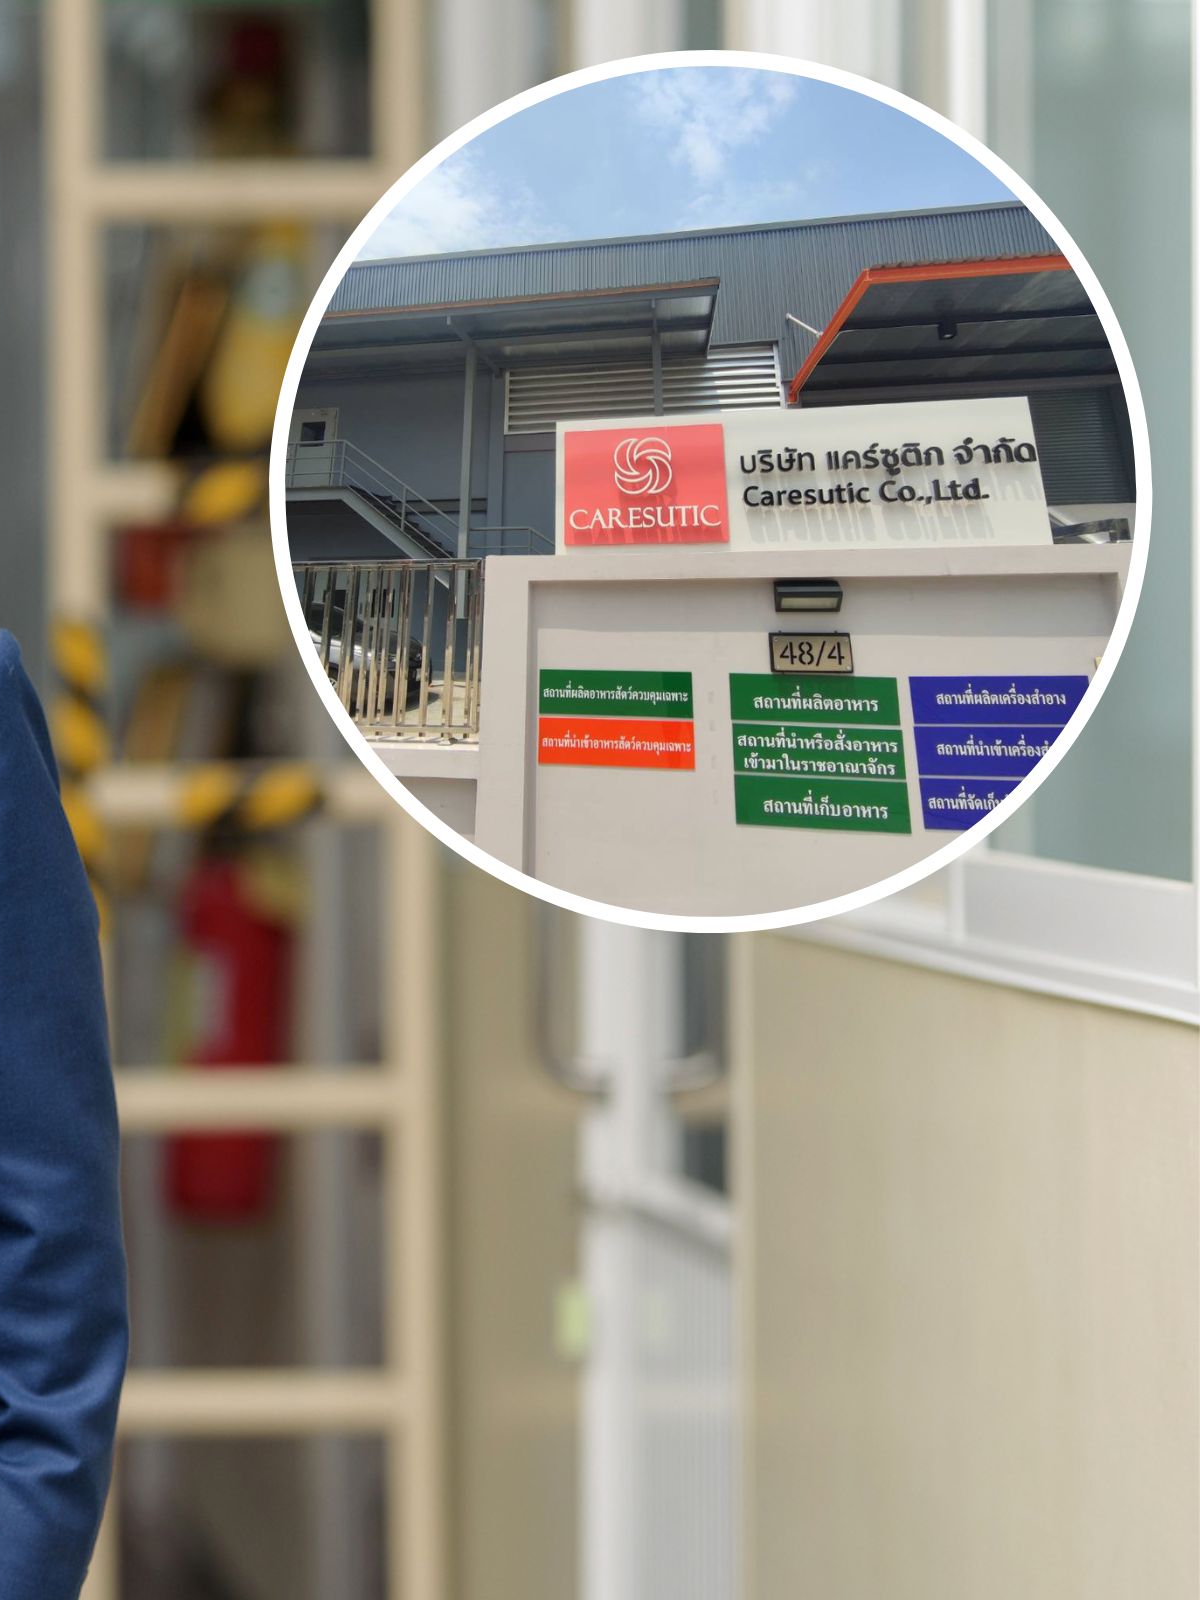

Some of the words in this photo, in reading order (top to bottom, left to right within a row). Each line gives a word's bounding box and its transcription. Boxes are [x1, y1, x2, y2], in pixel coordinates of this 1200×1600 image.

[740, 447, 815, 474] บริษัท
[826, 443, 945, 476] แคร์ซูติก
[952, 437, 1037, 465] จำกัด
[743, 482, 871, 507] Caresutic
[879, 478, 990, 505] Co.,Ltd.
[569, 504, 722, 531] CARESUTIC
[779, 641, 845, 666] 48/4
[543, 680, 689, 705] สถานที่ผลิตอาหารสัตว์ควบคุมเฉพาะ
[753, 685, 879, 712] สถานที่ผลิตอาหาร
[936, 683, 1067, 705] สถานที่ผลิตเครื่องสำอาง
[542, 730, 692, 755] สถานที่นำเข้าอาหารสัตว์ควบคุมเฉพาะ
[737, 727, 898, 753] สถานที่นำหรือสั่งอาหาร
[744, 752, 896, 776] เข้ามาในราชอาณาจักร
[763, 790, 888, 819] สถานที่เก็บอาหาร
